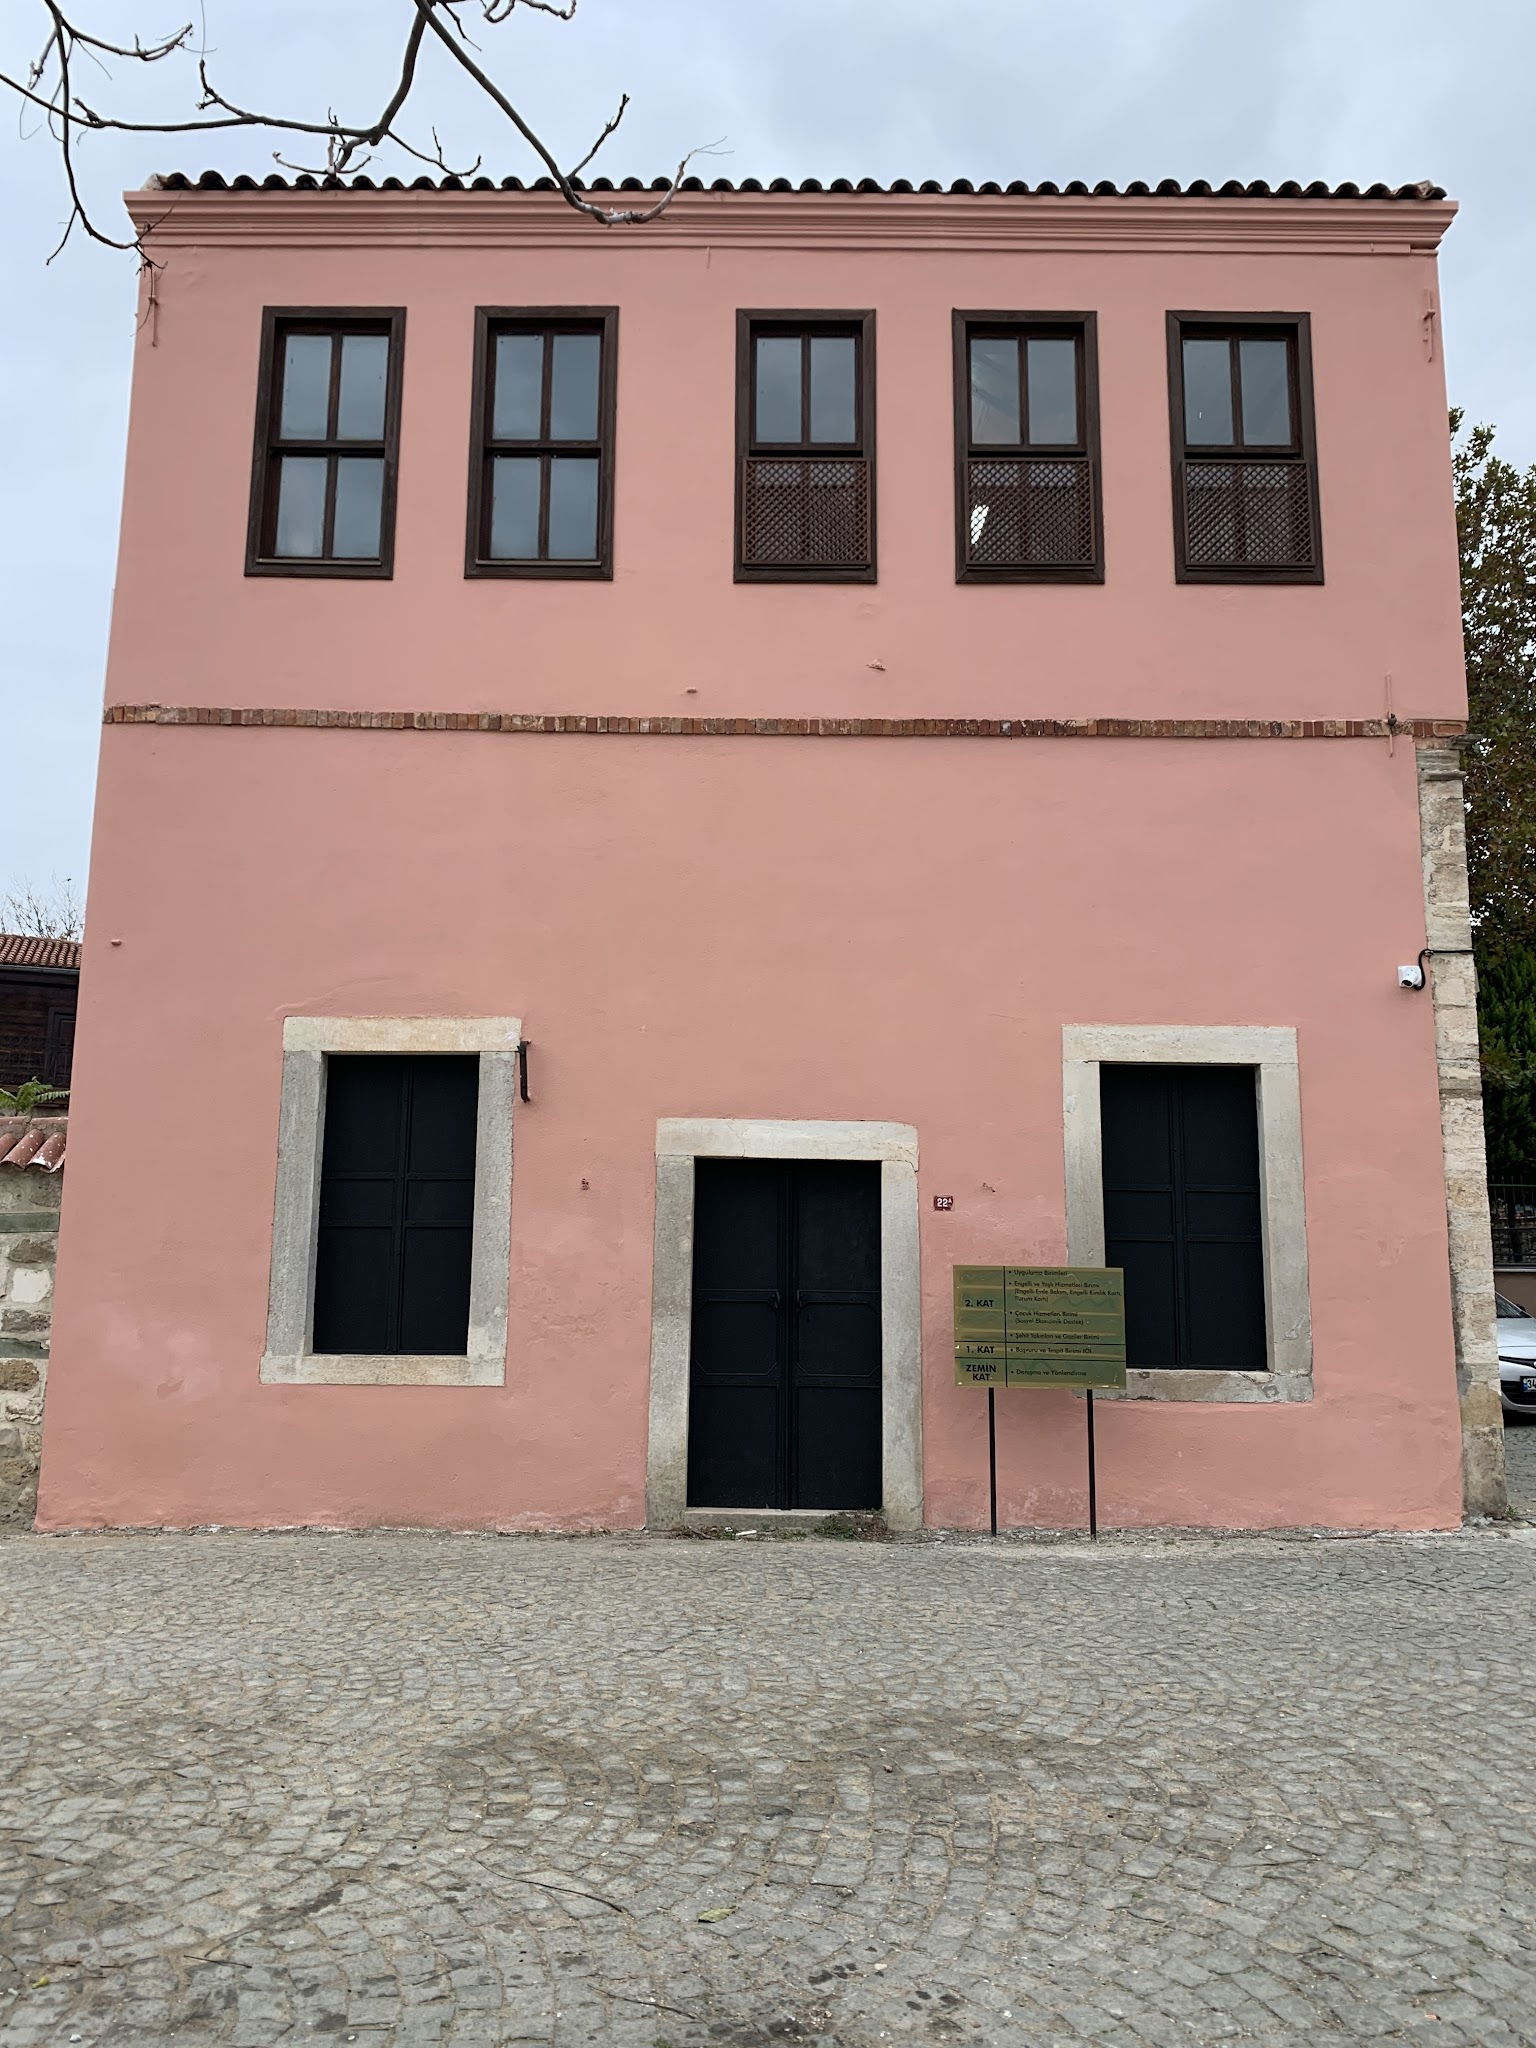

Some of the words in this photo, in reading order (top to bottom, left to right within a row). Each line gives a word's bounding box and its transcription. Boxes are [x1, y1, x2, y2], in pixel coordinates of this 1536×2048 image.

[965, 1299, 974, 1307] 2.
[976, 1299, 994, 1308] KAT
[966, 1345, 975, 1353] 1.
[977, 1345, 995, 1354] KAT
[966, 1362, 997, 1372] ZEMİN
[973, 1373, 990, 1381] KAT
